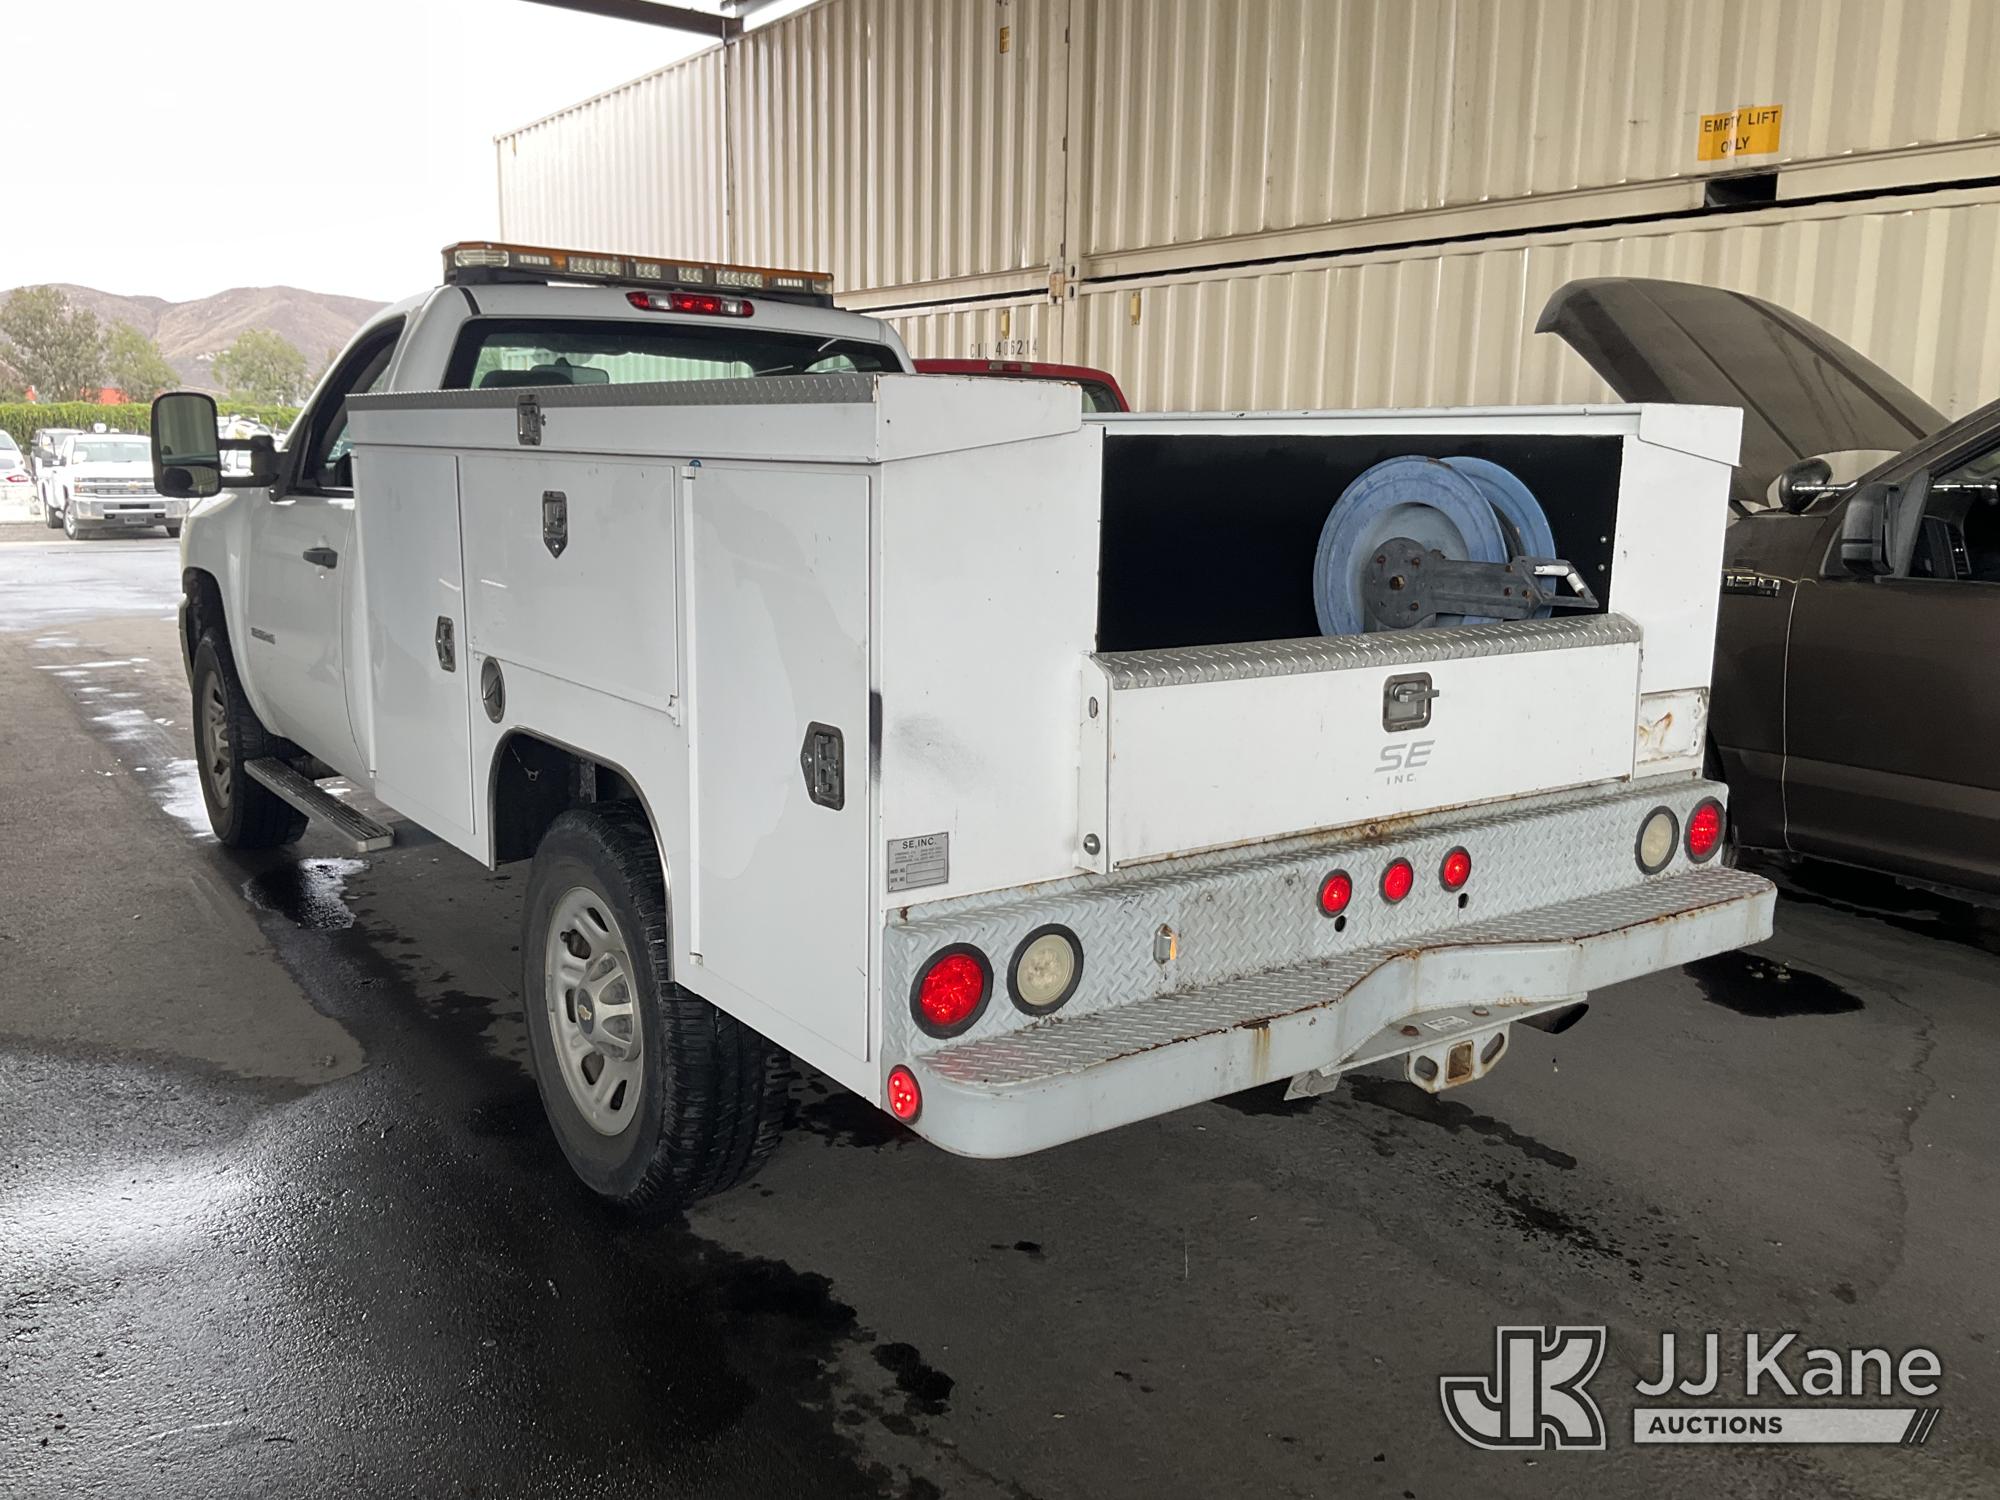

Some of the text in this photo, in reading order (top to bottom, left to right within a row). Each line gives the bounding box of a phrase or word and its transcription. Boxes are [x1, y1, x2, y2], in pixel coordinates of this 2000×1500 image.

[1704, 110, 1779, 132] EMPTY LIFT
[1374, 739, 1436, 773] SE
